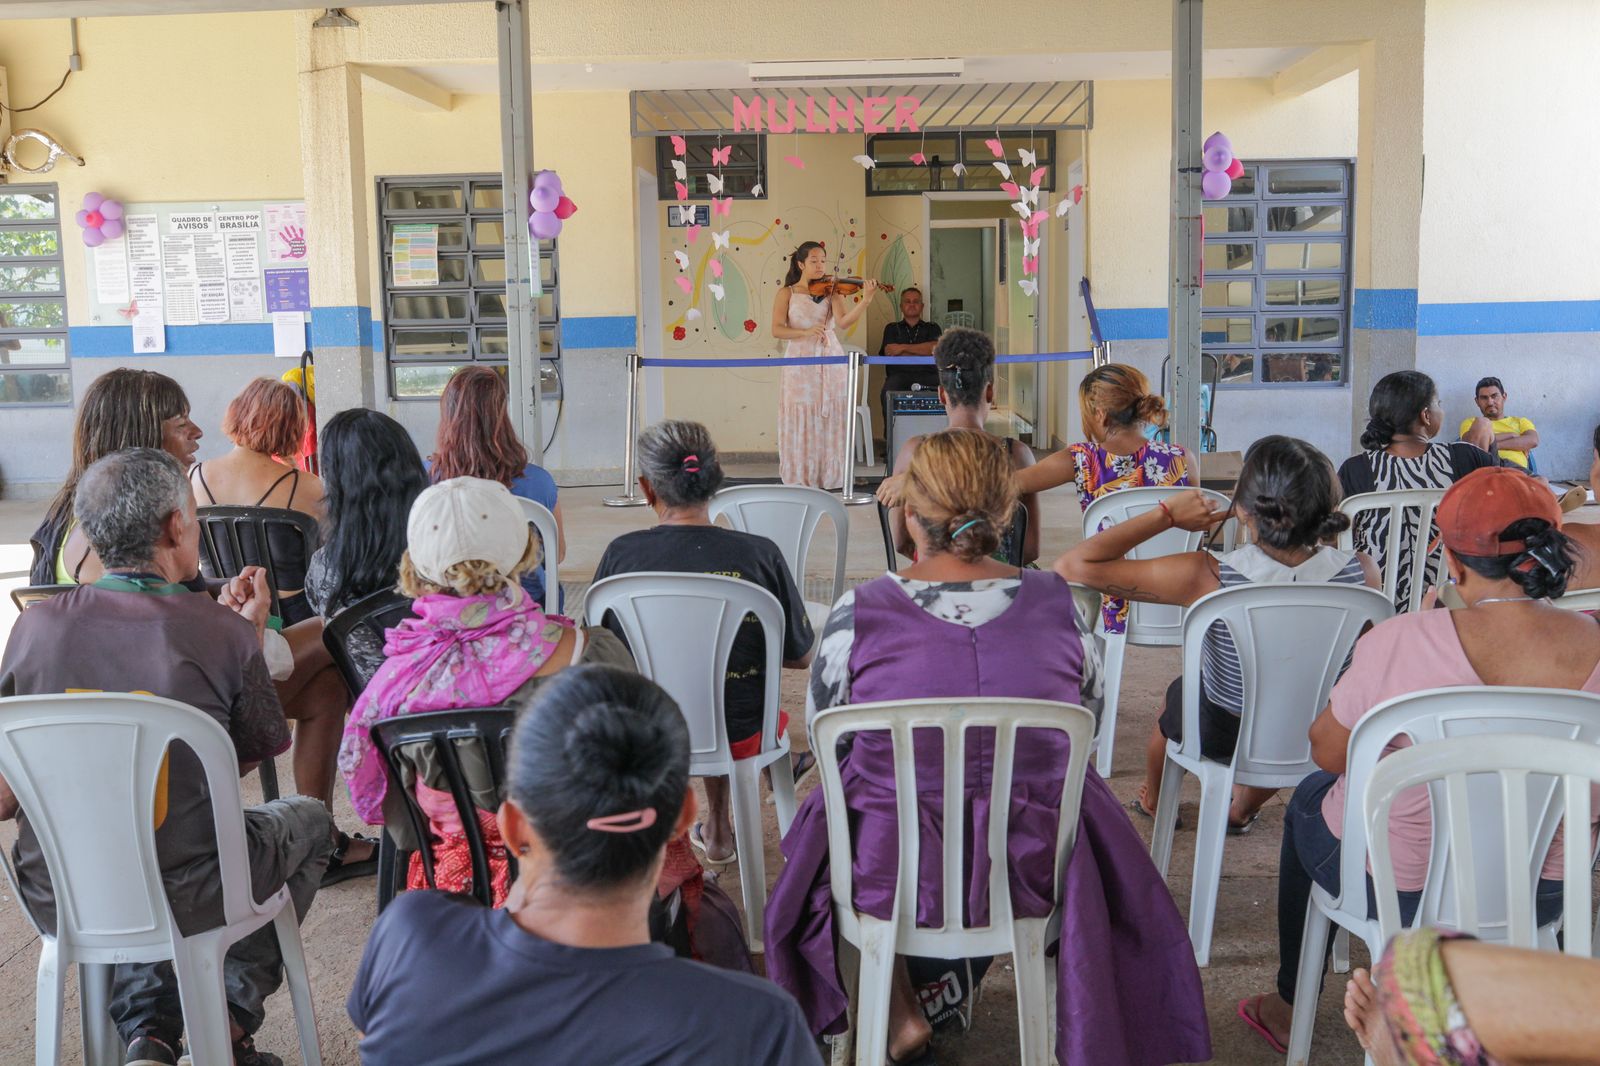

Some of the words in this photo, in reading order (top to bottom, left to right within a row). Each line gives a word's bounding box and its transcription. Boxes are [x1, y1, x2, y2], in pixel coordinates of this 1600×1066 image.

[732, 95, 921, 134] MULHER
[177, 222, 209, 230] AVISOS
[220, 220, 259, 229] BRASÍLIA
